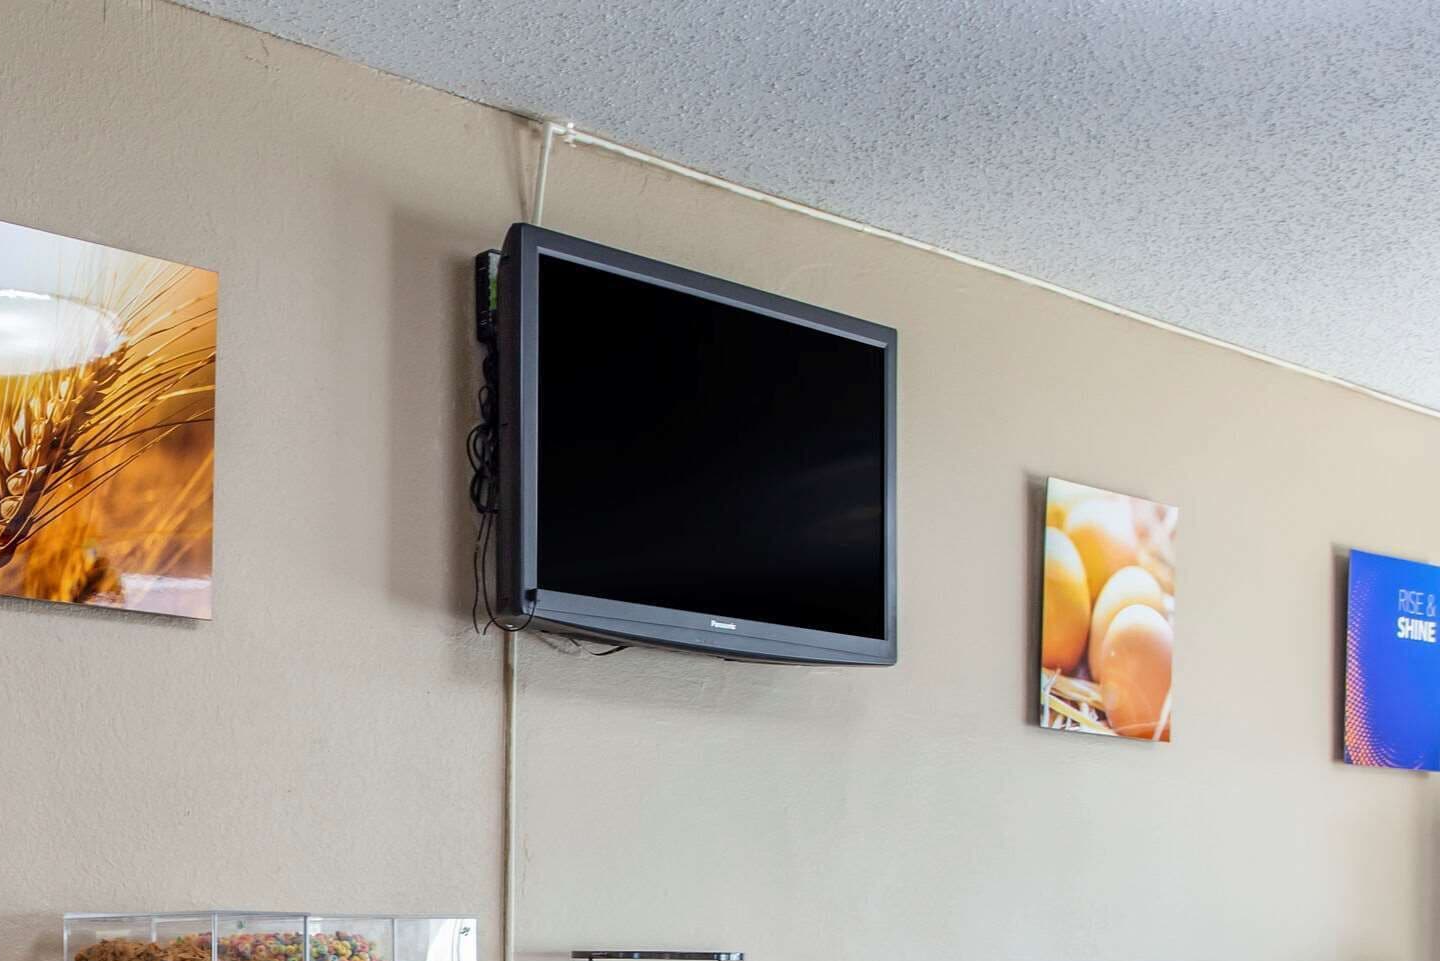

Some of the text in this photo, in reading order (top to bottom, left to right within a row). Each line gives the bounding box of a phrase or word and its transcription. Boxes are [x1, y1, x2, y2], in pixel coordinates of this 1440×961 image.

[1398, 589, 1436, 617] RISE &
[1396, 616, 1437, 642] SHINE
